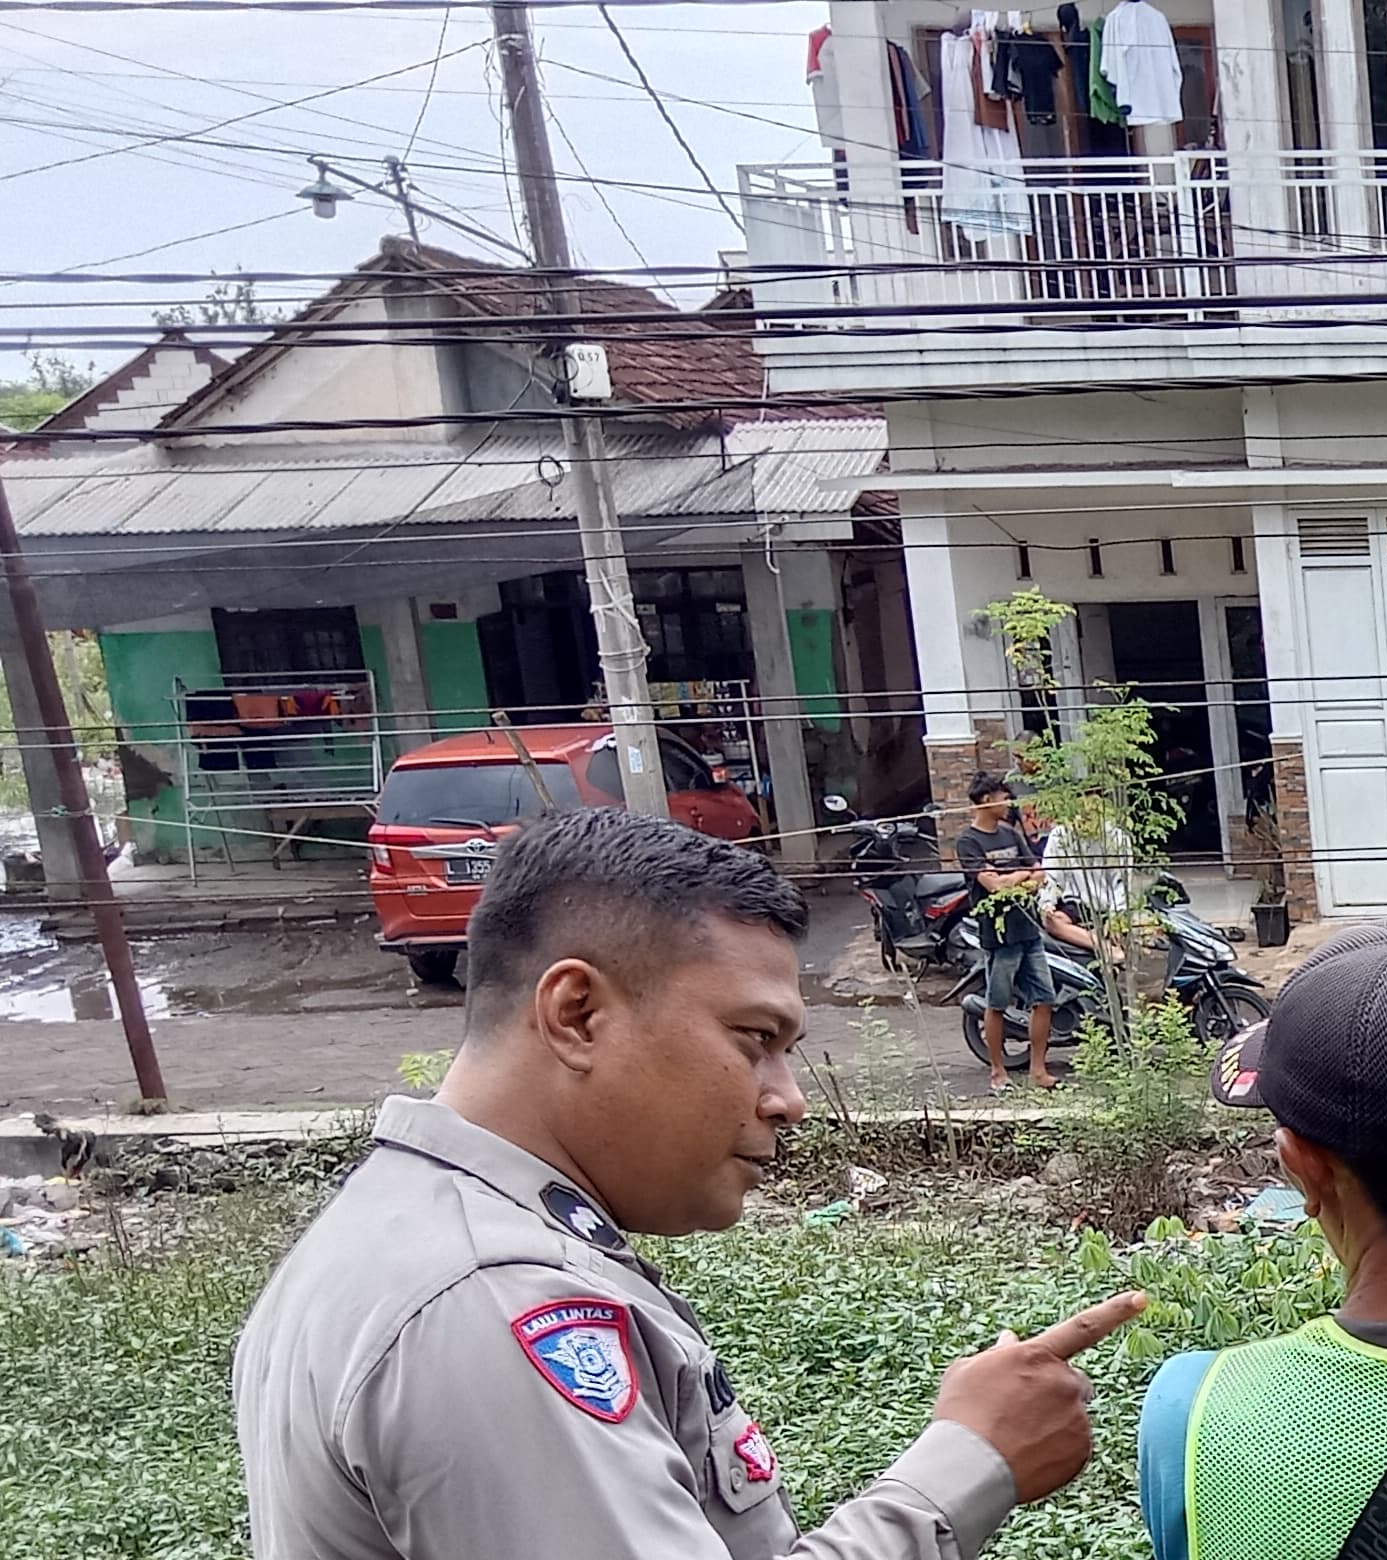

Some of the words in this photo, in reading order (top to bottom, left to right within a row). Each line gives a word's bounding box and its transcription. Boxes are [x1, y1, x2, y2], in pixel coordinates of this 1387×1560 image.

[446, 861, 455, 875] L
[521, 1312, 558, 1335] LALU
[560, 1307, 613, 1321] LINTAS
